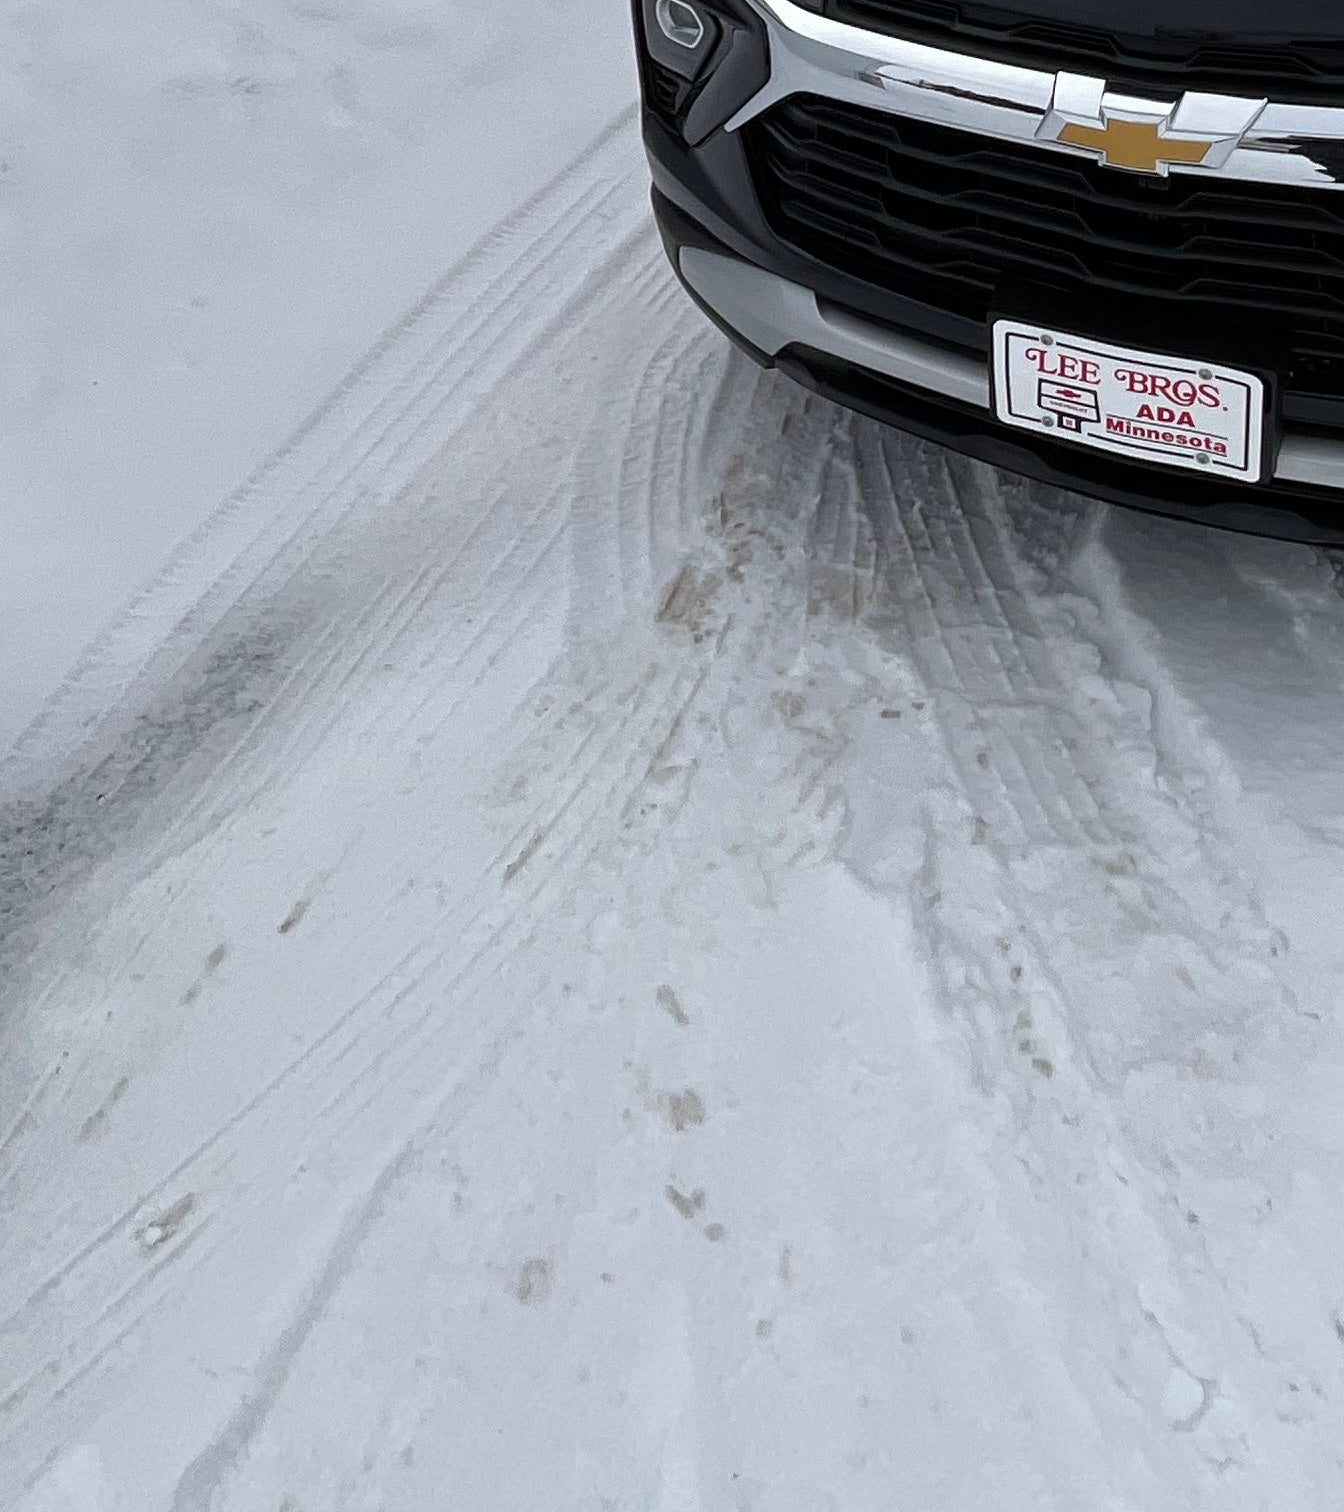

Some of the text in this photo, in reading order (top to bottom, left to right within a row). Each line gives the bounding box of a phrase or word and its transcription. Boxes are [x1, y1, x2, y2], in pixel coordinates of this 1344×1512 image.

[1025, 348, 1229, 411] LEE BROS.
[1136, 404, 1196, 428] ADA
[1106, 418, 1227, 453] Minnesota
